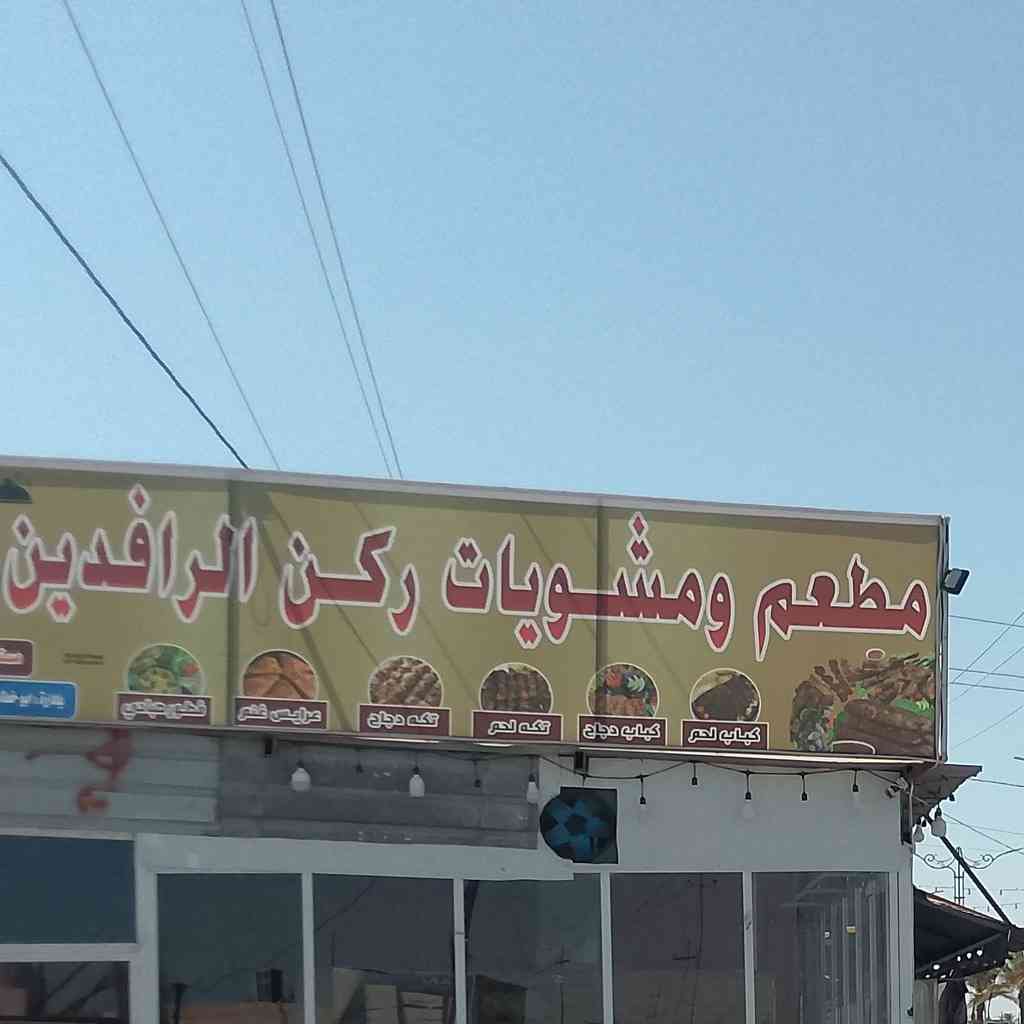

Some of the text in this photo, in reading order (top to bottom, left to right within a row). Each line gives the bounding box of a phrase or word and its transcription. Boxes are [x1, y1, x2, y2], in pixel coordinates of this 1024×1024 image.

[3, 483, 930, 661] مطعم ومشويات ركن الرافدين
[368, 710, 405, 729] دجاج
[488, 719, 517, 736] لحم
[583, 722, 661, 741] كباب دجاج
[688, 727, 761, 745] كباب لحم
